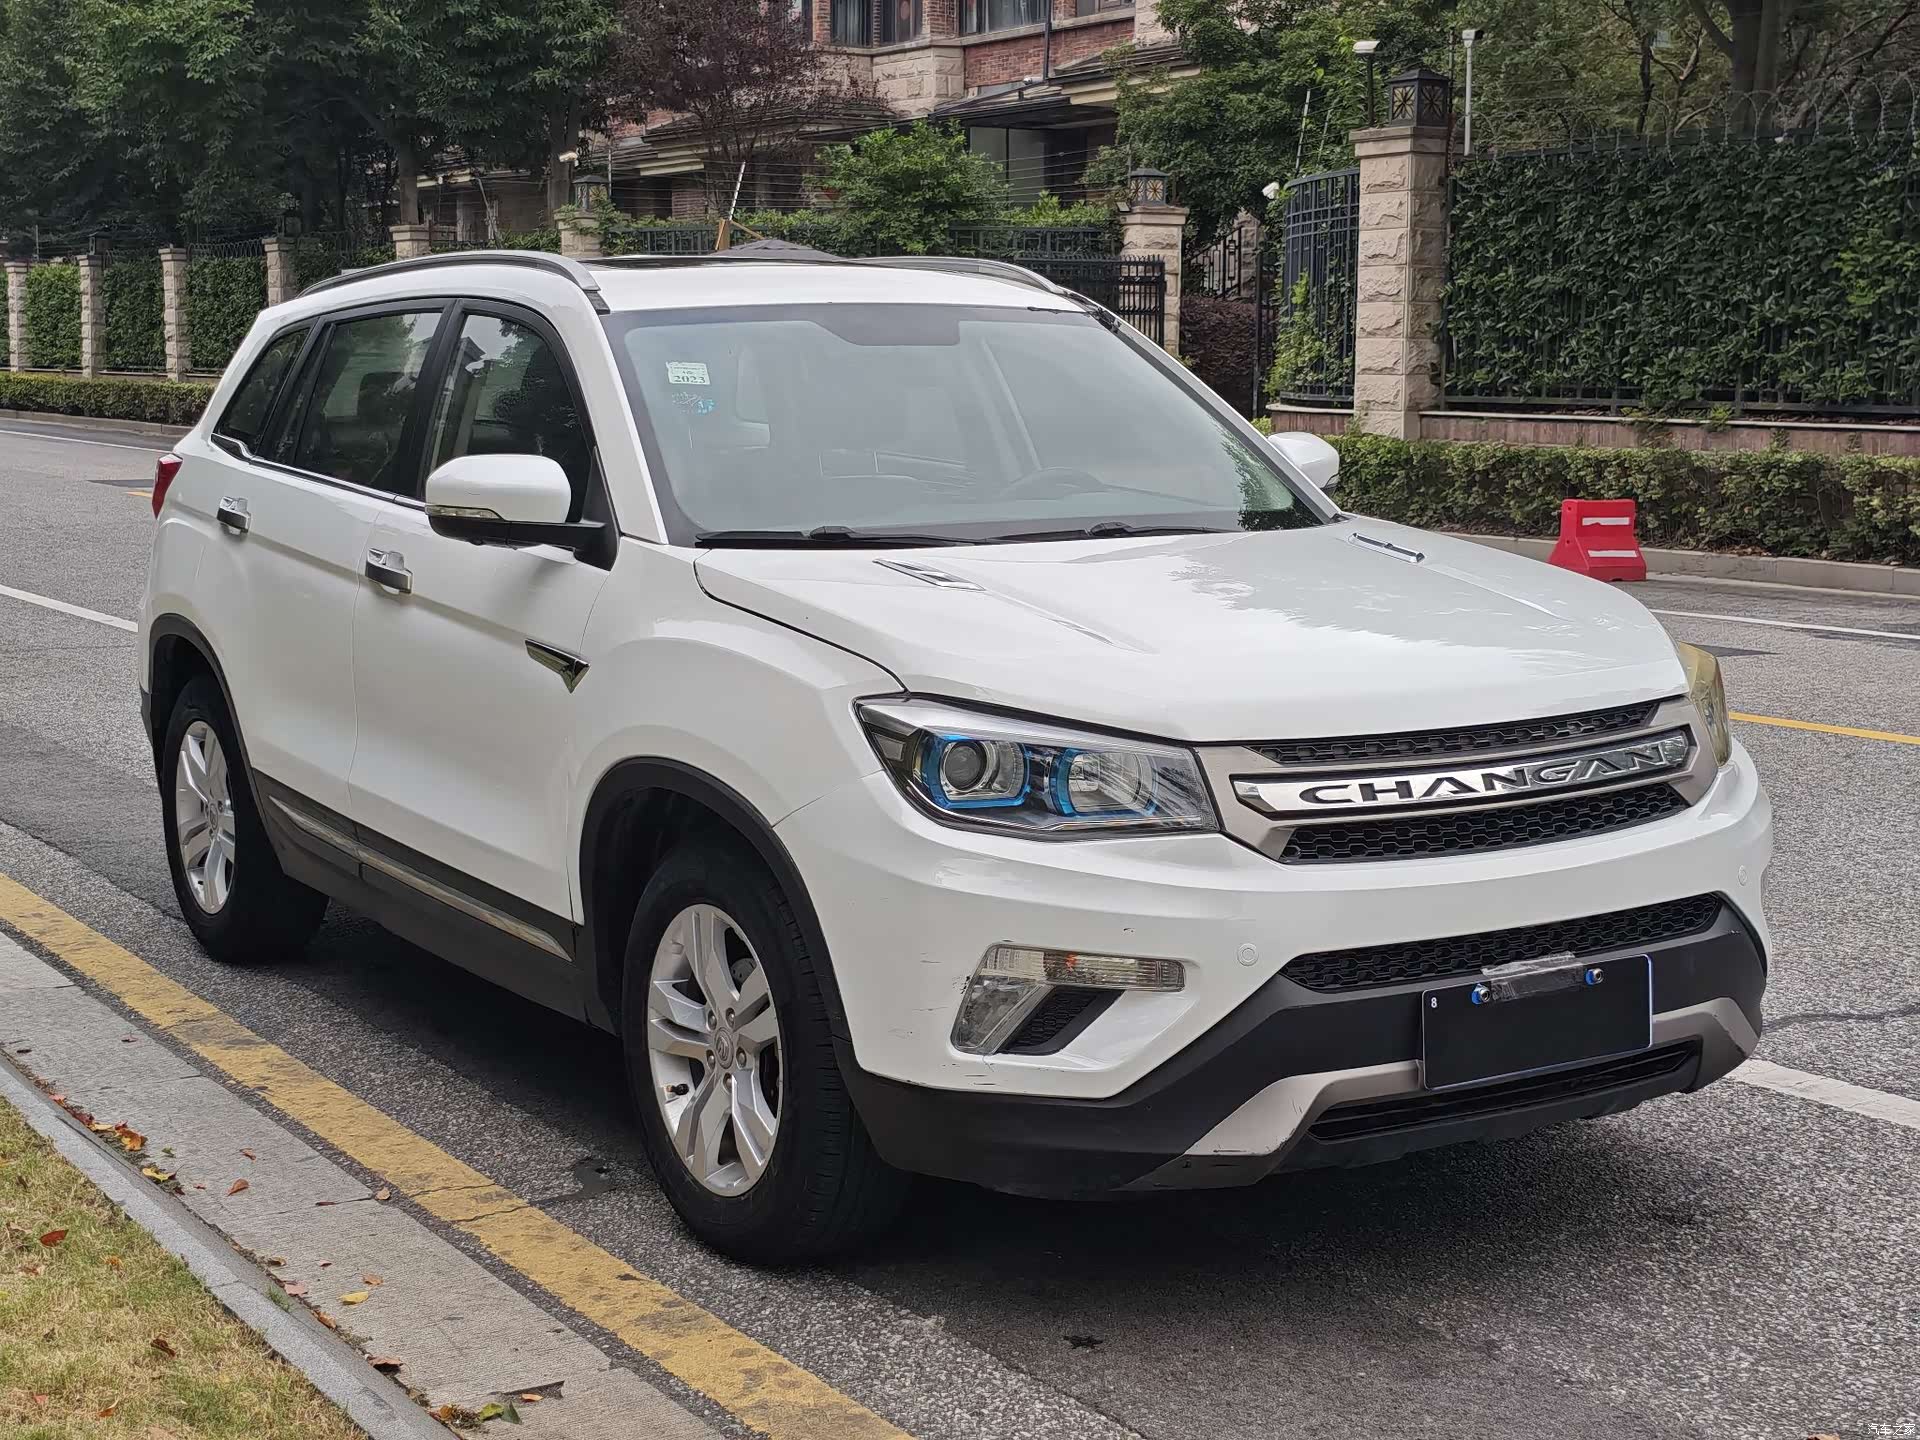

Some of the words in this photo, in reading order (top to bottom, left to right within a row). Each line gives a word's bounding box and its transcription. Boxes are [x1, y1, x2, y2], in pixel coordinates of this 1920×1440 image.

[674, 375, 706, 383] 2023
[1299, 743, 1669, 804] CHANGAN
[1431, 997, 1438, 1008] 8
